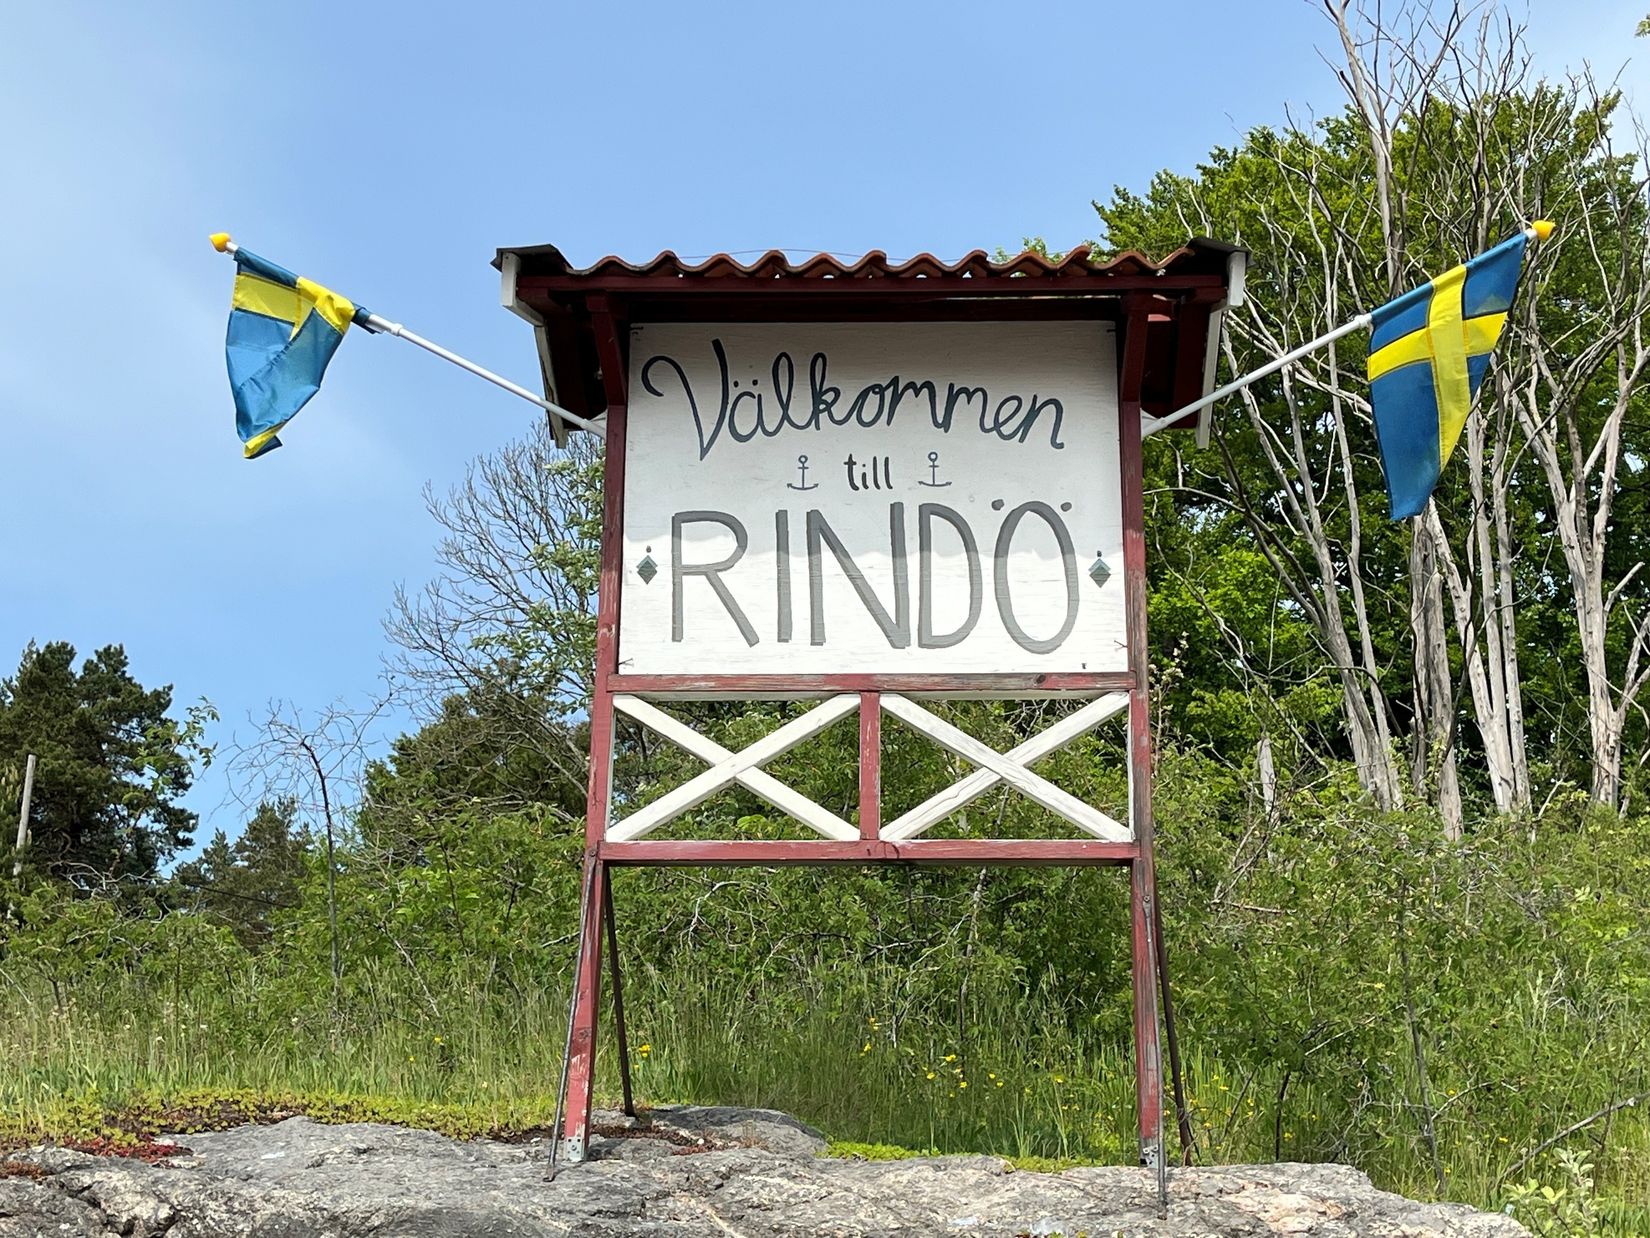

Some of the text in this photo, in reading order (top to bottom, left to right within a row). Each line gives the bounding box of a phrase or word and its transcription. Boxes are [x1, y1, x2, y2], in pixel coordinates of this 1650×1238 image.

[641, 338, 1065, 461] Välkommen
[844, 453, 893, 491] till
[671, 499, 1079, 655] RINDÖ
